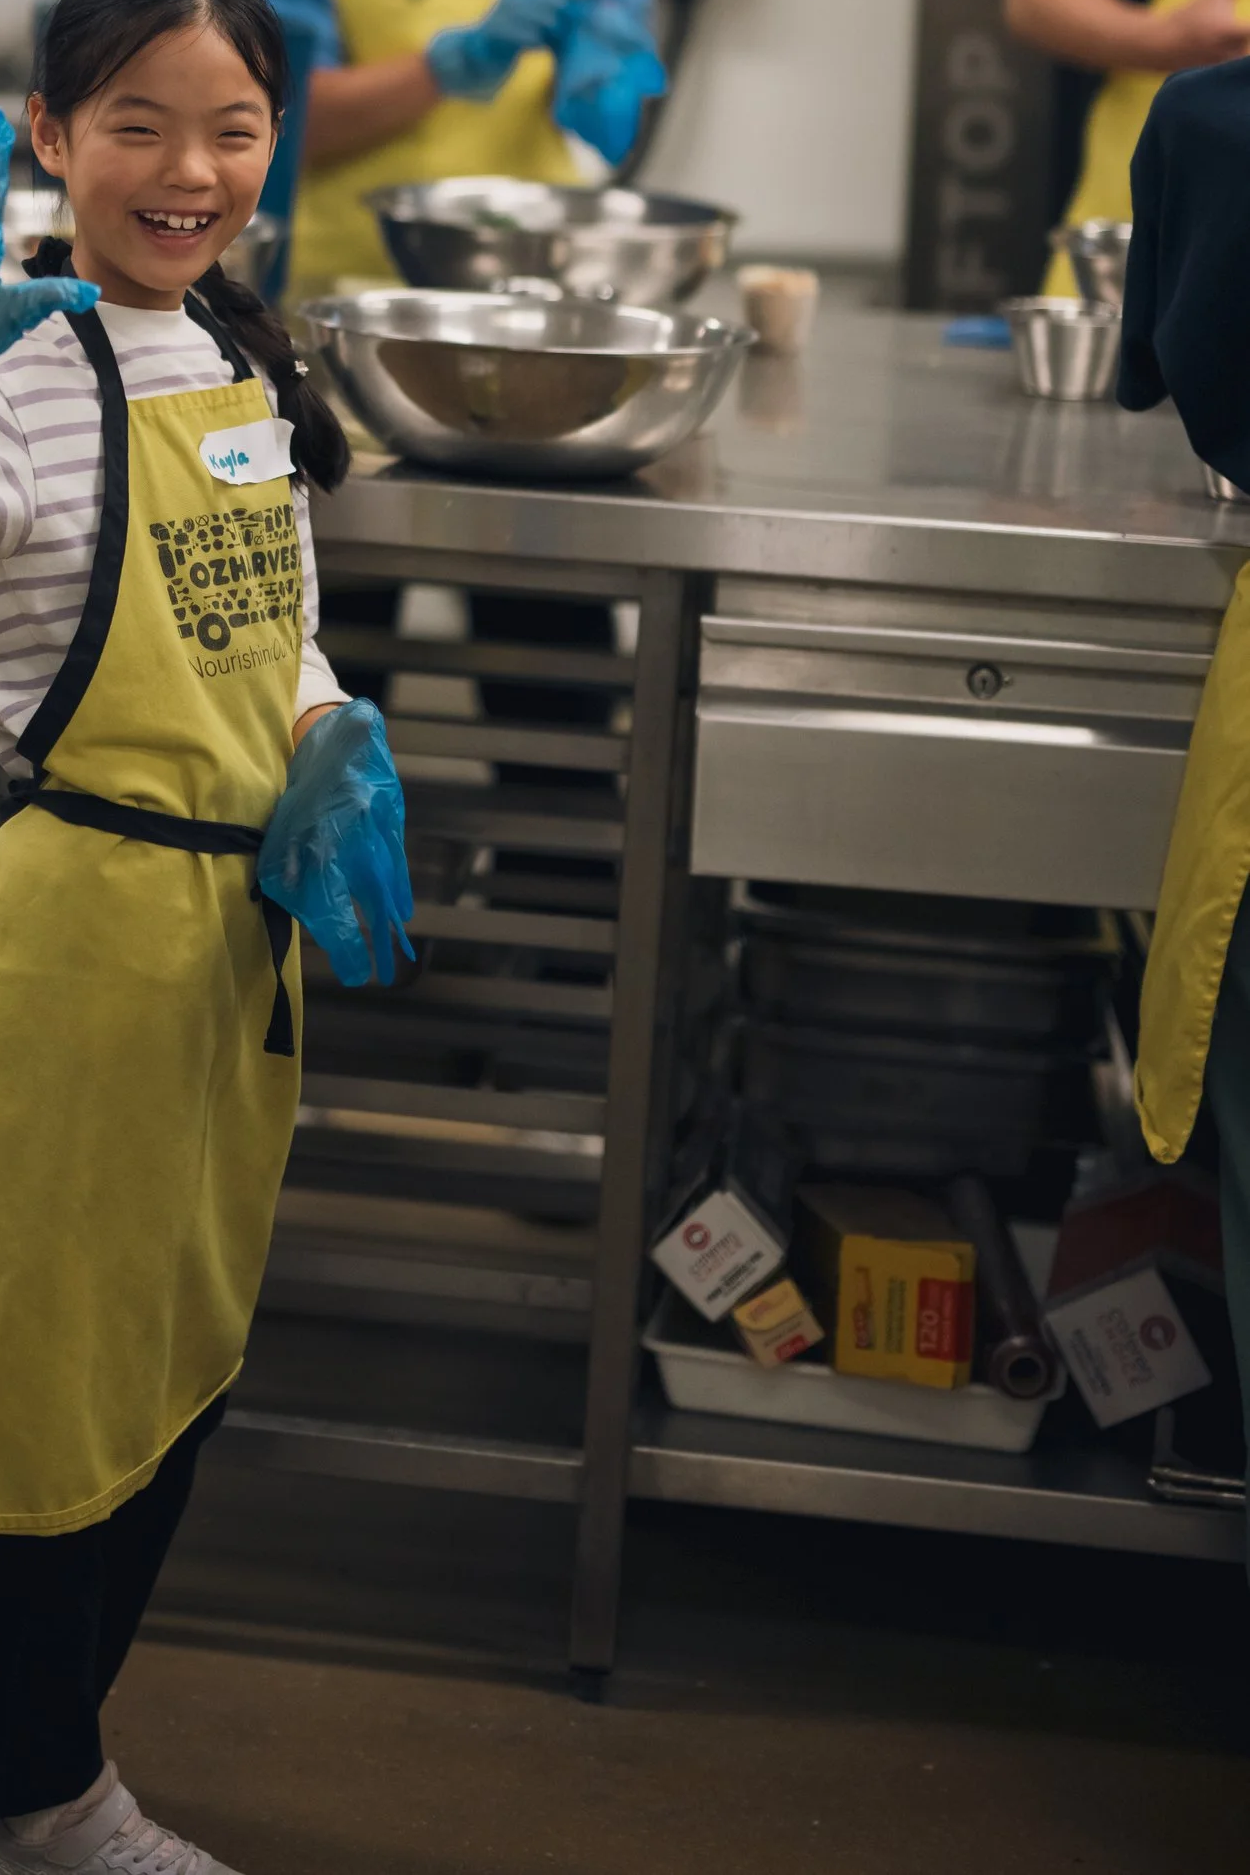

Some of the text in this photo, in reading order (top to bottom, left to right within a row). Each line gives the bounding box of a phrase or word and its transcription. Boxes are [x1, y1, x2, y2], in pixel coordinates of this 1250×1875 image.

[208, 448, 249, 478] Kayla
[190, 543, 302, 589] OZHRVES
[188, 644, 274, 679] Nourishin
[919, 1309, 940, 1353] 120
